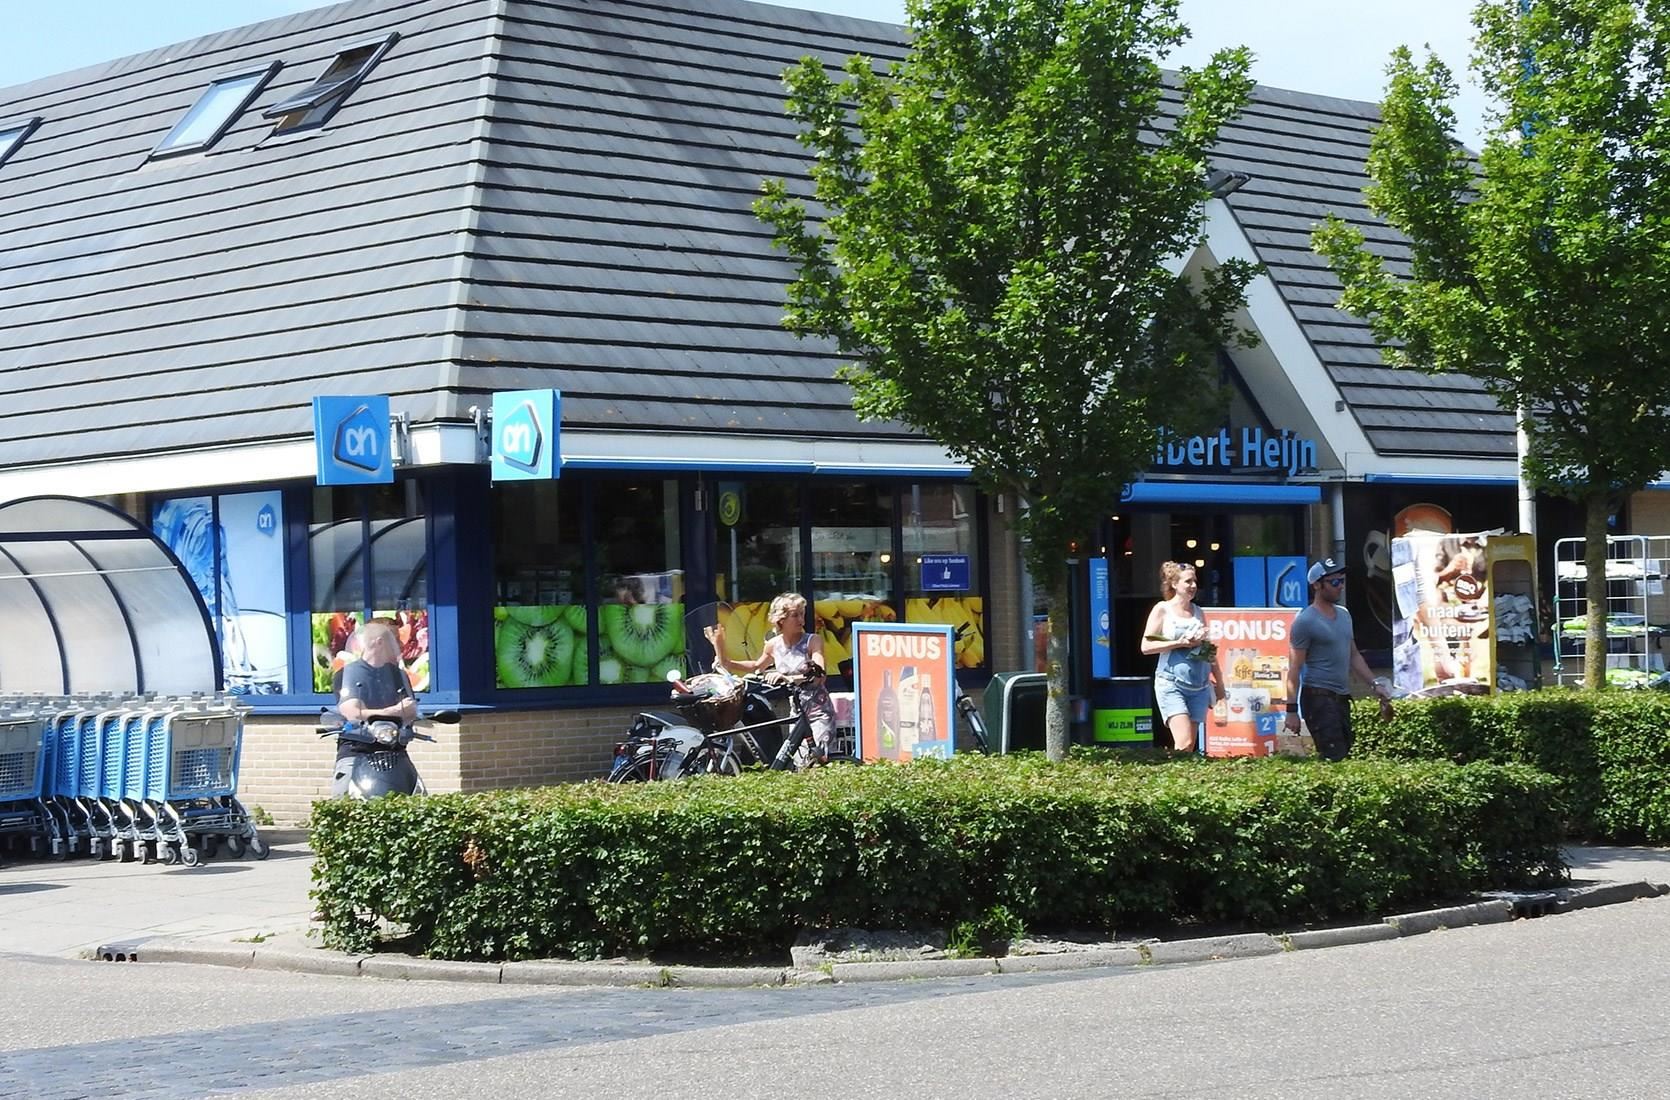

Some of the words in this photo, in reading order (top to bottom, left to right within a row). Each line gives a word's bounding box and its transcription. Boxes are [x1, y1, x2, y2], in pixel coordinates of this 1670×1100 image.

[1242, 427, 1317, 477] Heijn
[1427, 605, 1459, 619] naar
[1209, 619, 1287, 641] BONUS
[1420, 623, 1472, 638] buiten!
[866, 634, 941, 660] BONUS
